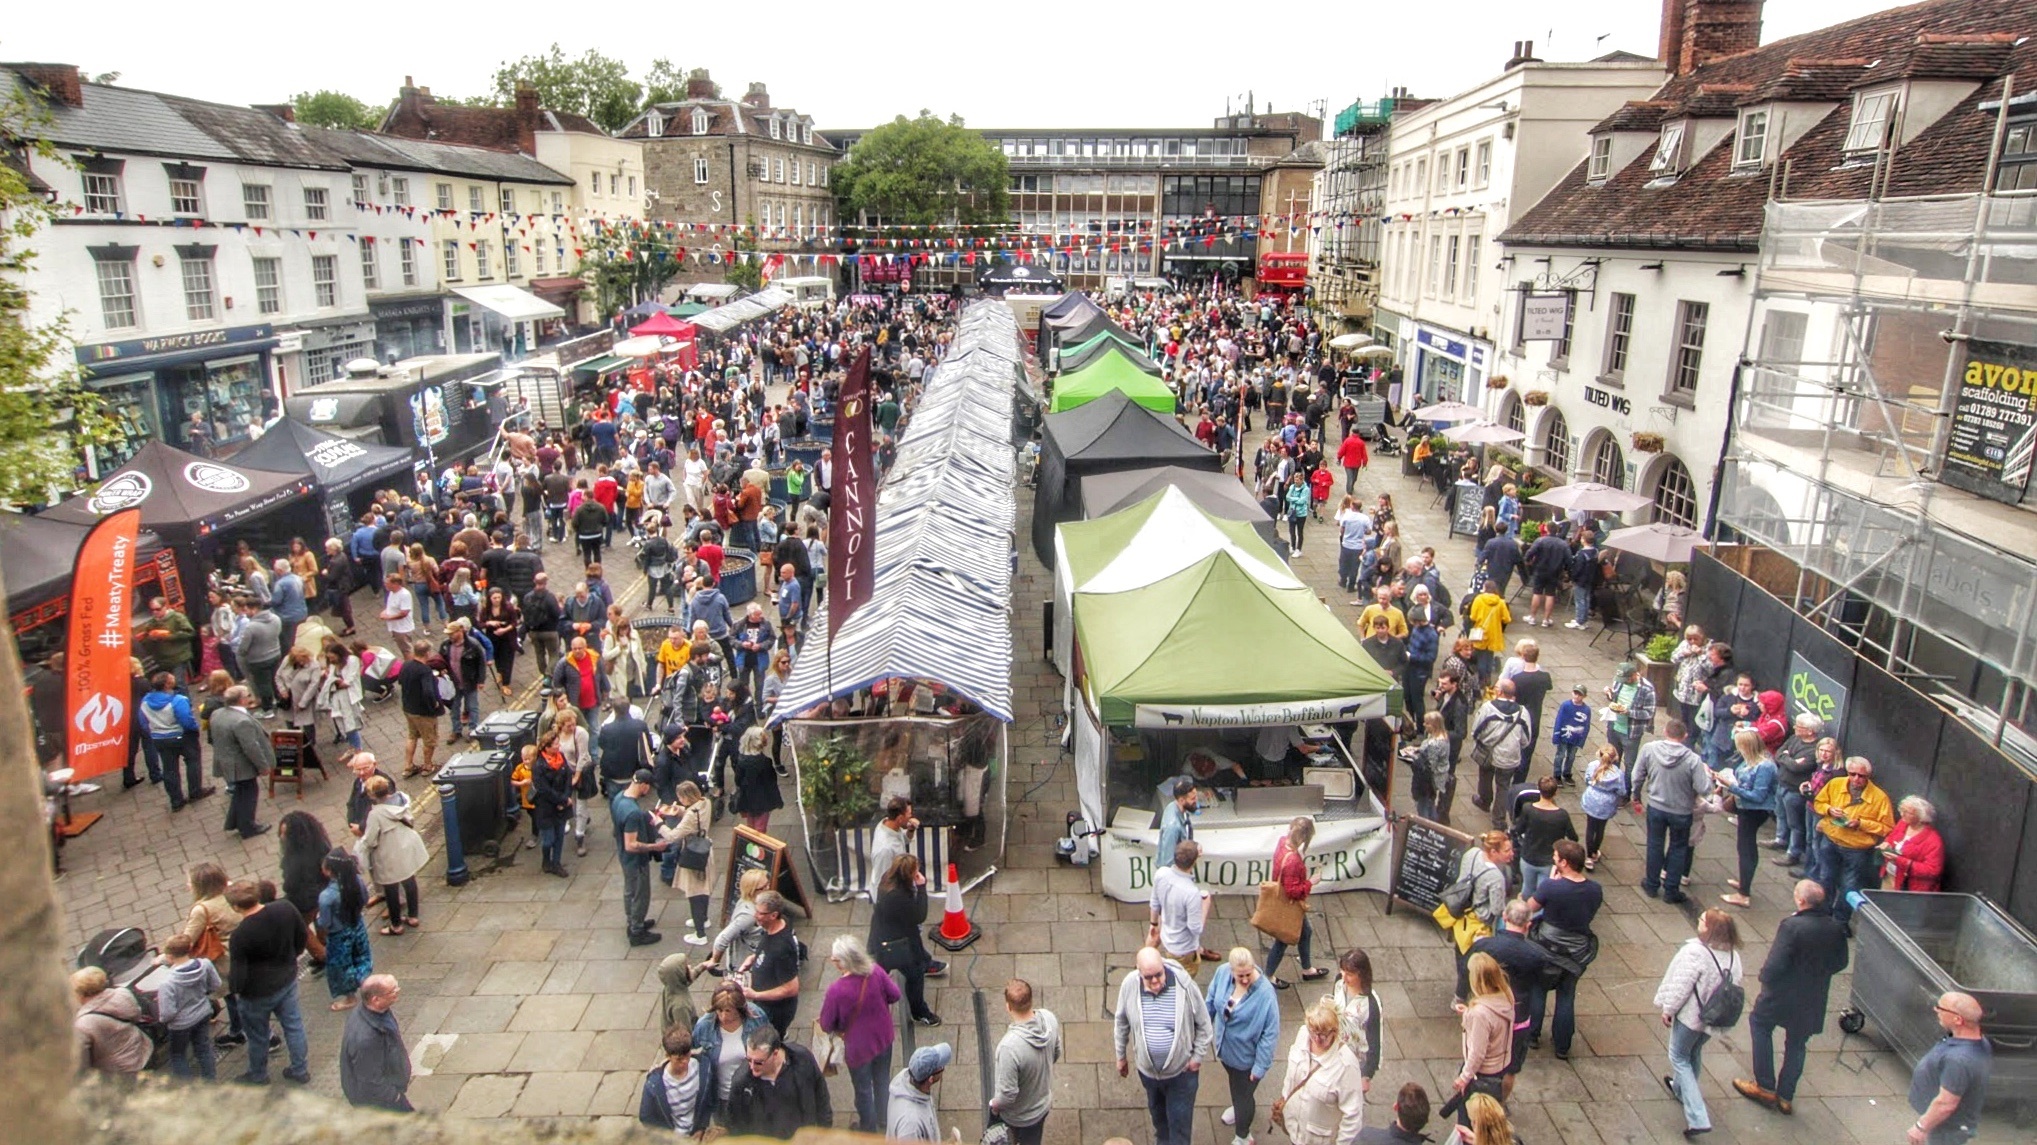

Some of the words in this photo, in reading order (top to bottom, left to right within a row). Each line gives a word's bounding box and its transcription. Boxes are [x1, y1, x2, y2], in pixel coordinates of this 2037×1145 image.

[1527, 307, 1548, 315] TILTED
[1549, 307, 1564, 315] WIG
[142, 335, 192, 351] WARWICK
[194, 330, 227, 345] BOOKS
[1965, 360, 2037, 396] avon
[1585, 385, 1610, 408] TILTED
[1611, 394, 1632, 415] WIG
[1961, 386, 2028, 412] scaffolding
[1970, 403, 1997, 418] 01789
[1998, 409, 2033, 427] 777391
[224, 513, 235, 521] The
[845, 431, 863, 601] CANNOLI
[98, 535, 130, 648] #MeatyTreaty
[81, 597, 94, 620] Fed
[79, 622, 92, 657] Grass
[77, 660, 91, 691] 100%
[1792, 671, 1836, 721] dce
[1190, 706, 1239, 727] Napton
[1240, 708, 1281, 725] Water
[1282, 706, 1333, 724] Buffalo
